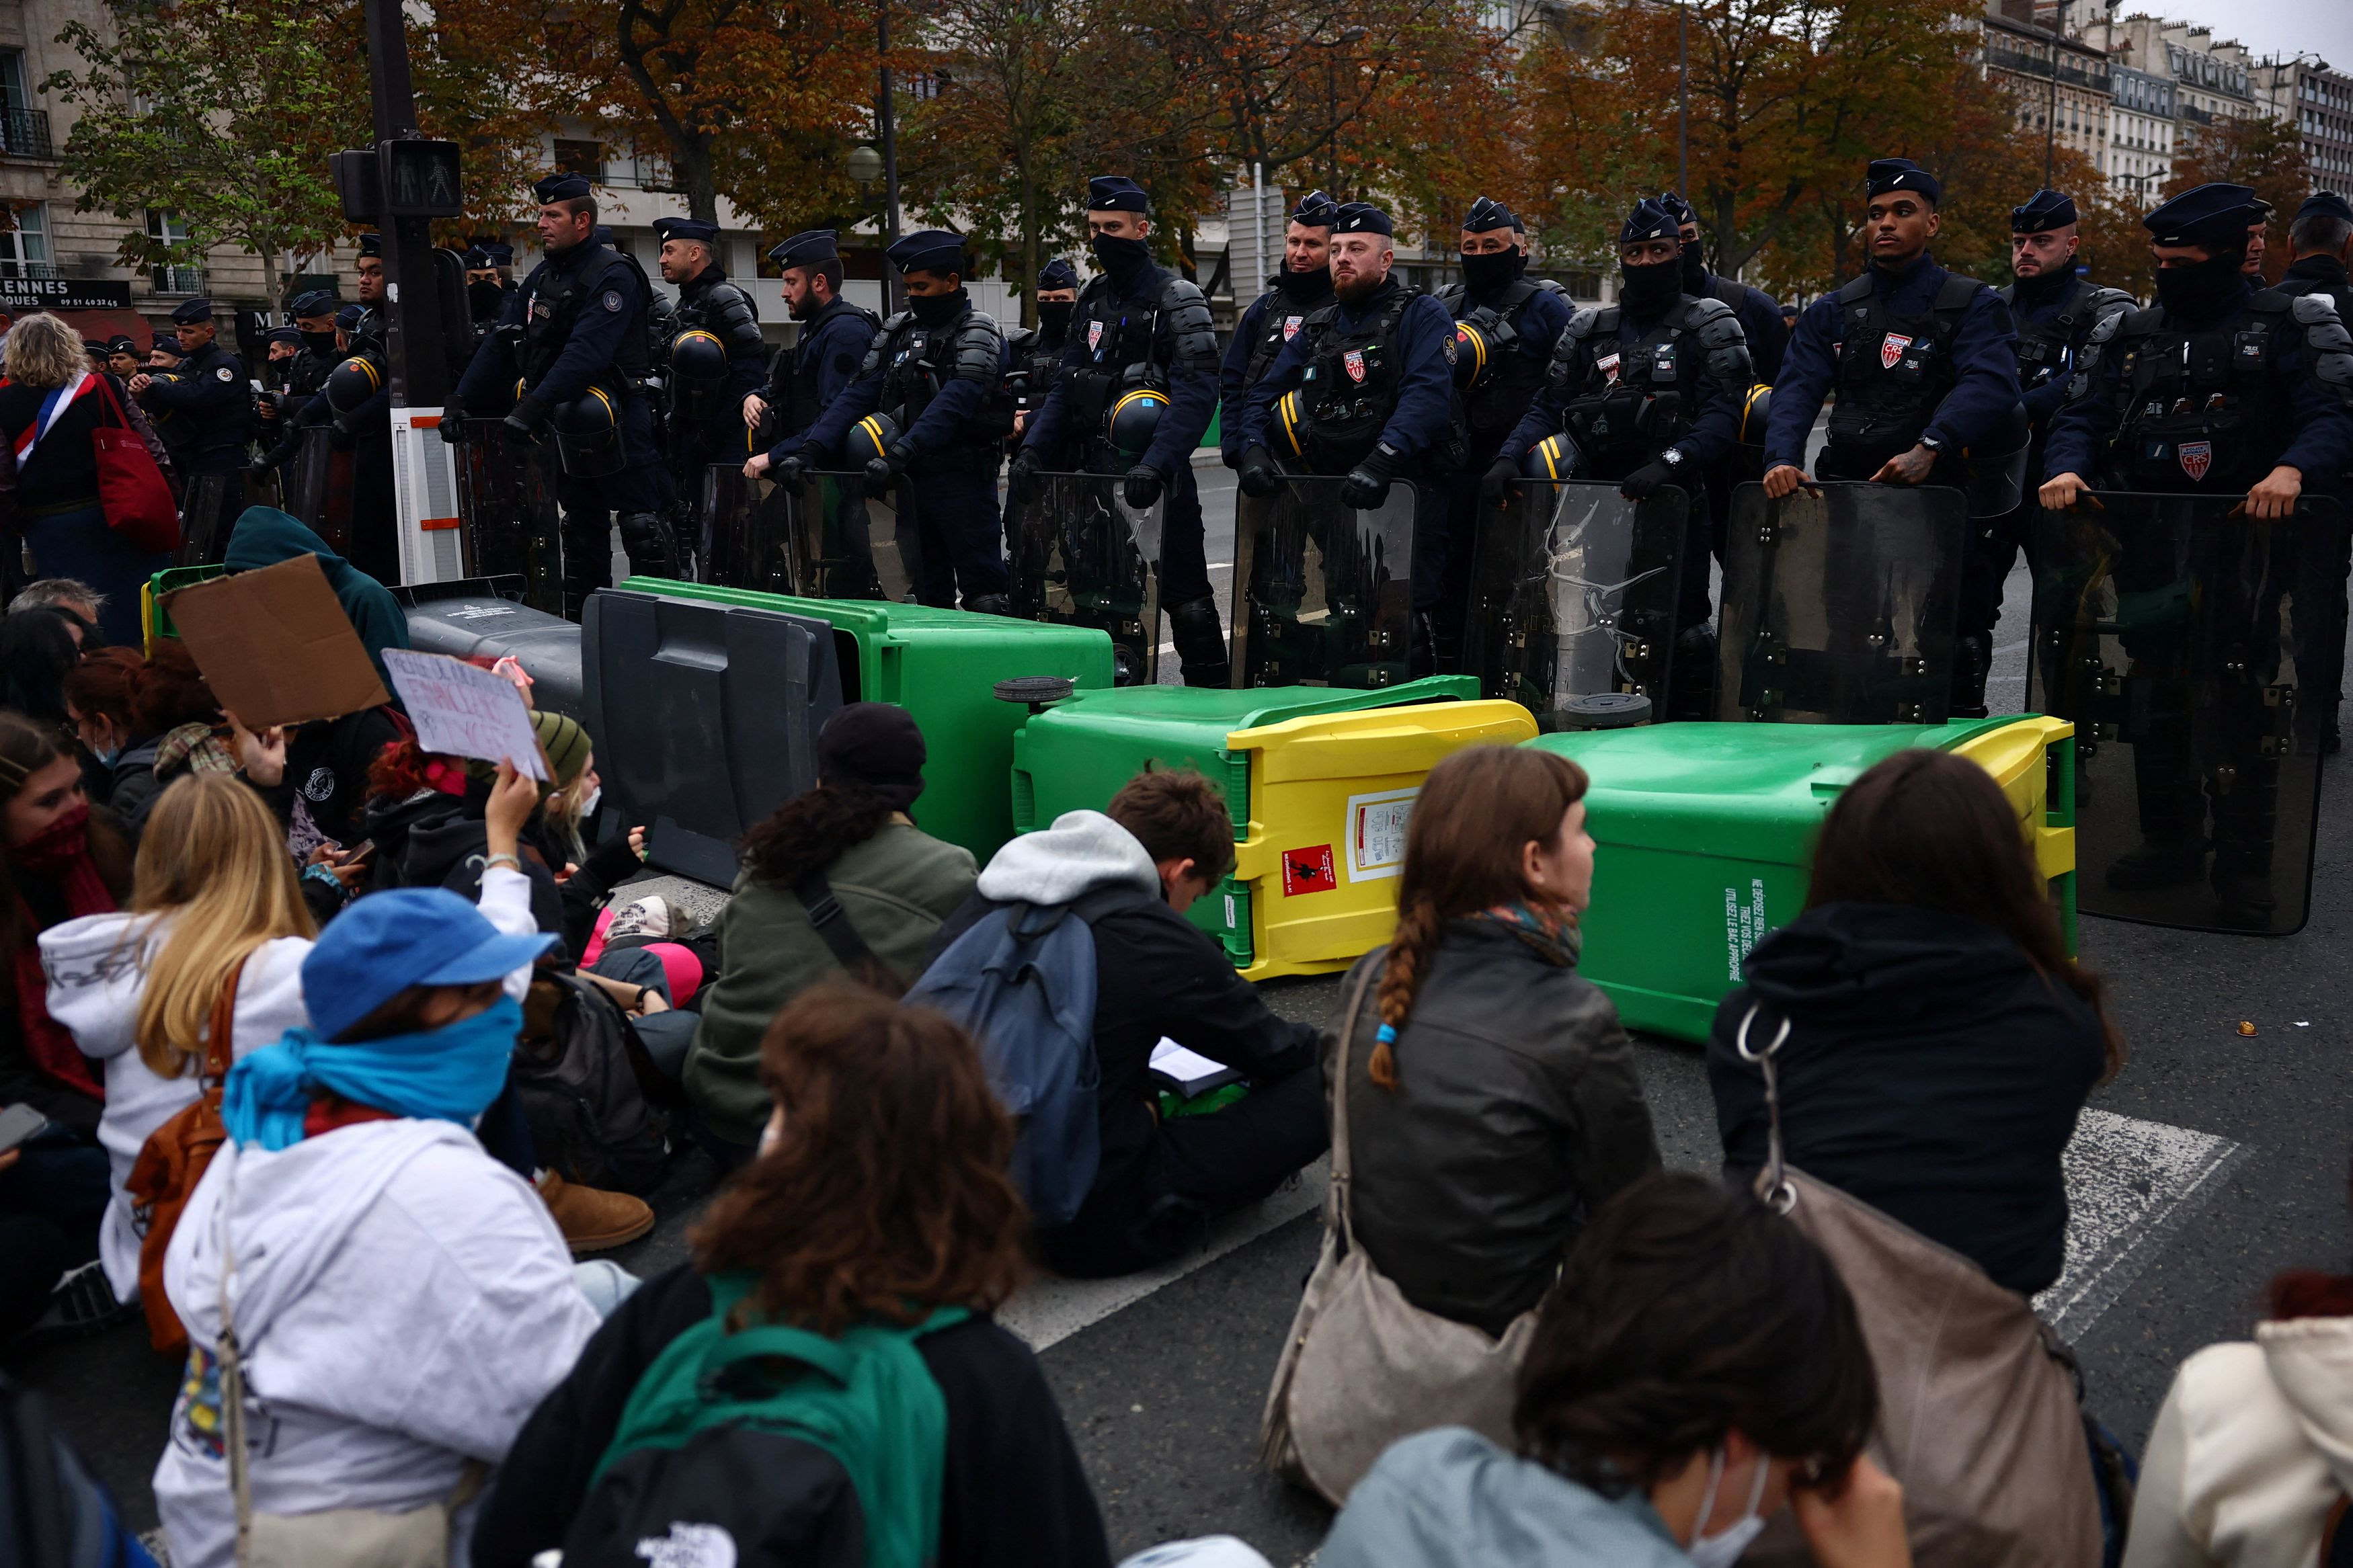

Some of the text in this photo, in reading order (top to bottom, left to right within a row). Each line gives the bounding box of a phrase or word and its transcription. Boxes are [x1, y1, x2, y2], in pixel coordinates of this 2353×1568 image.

[0, 280, 68, 294] ENNES
[1884, 344, 1903, 355] CRS
[1347, 360, 1364, 369] CRS
[2184, 454, 2208, 464] CRS
[1751, 878, 1763, 888] NE
[1752, 888, 1767, 915] DÉPOSEZ
[1740, 906, 1751, 923] TRIEZ
[1753, 916, 1765, 932] RIEN
[1725, 888, 1743, 982] UTILISEZ LE BAC APPROPRIÉ
[1741, 925, 1752, 938] VOS
